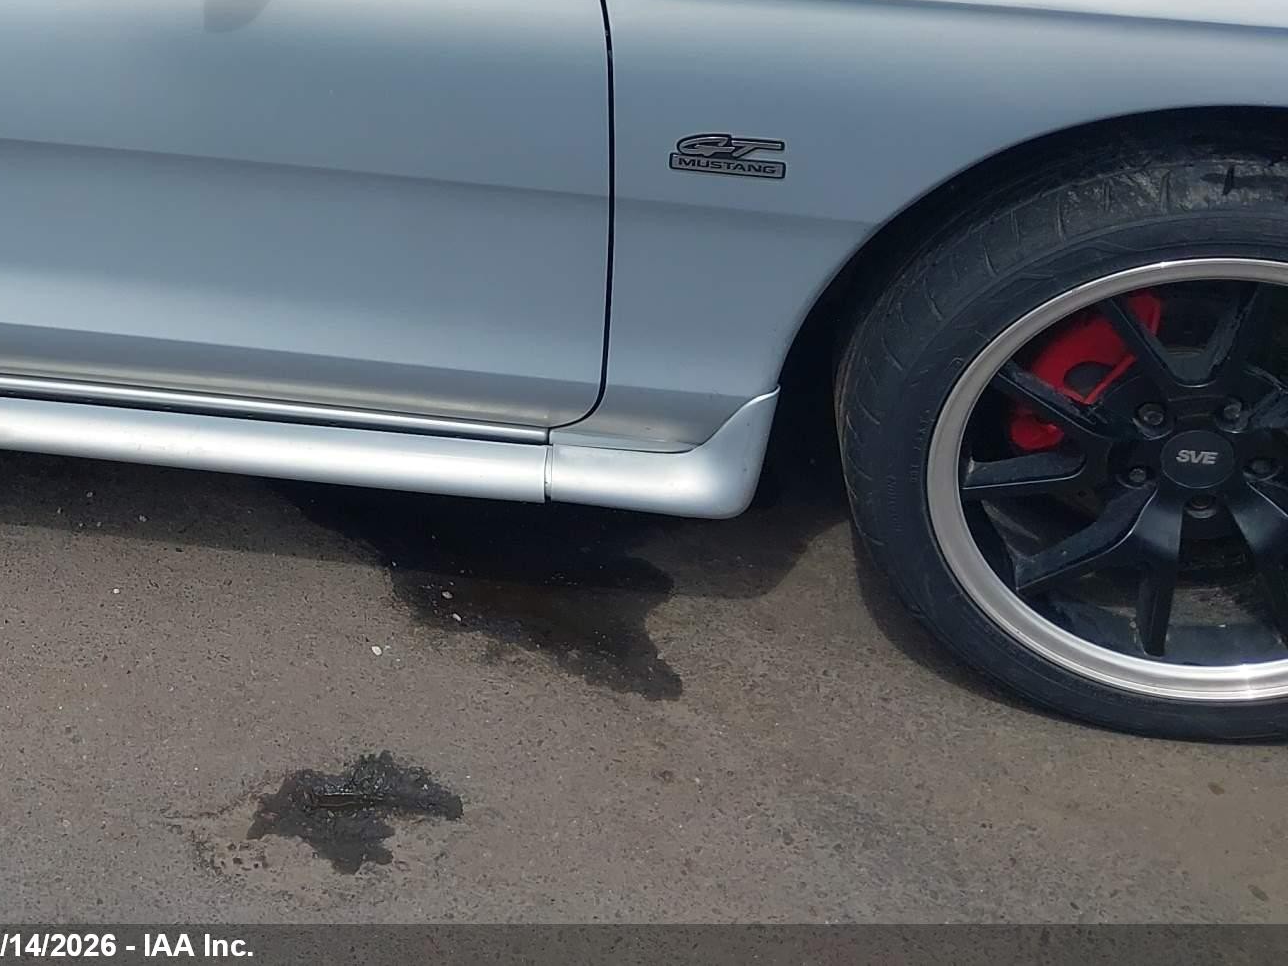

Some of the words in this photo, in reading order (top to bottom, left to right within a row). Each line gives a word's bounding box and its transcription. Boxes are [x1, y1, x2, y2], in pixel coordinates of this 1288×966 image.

[676, 134, 785, 159] GT
[675, 155, 779, 176] MUSTANG
[1175, 449, 1219, 465] SVE
